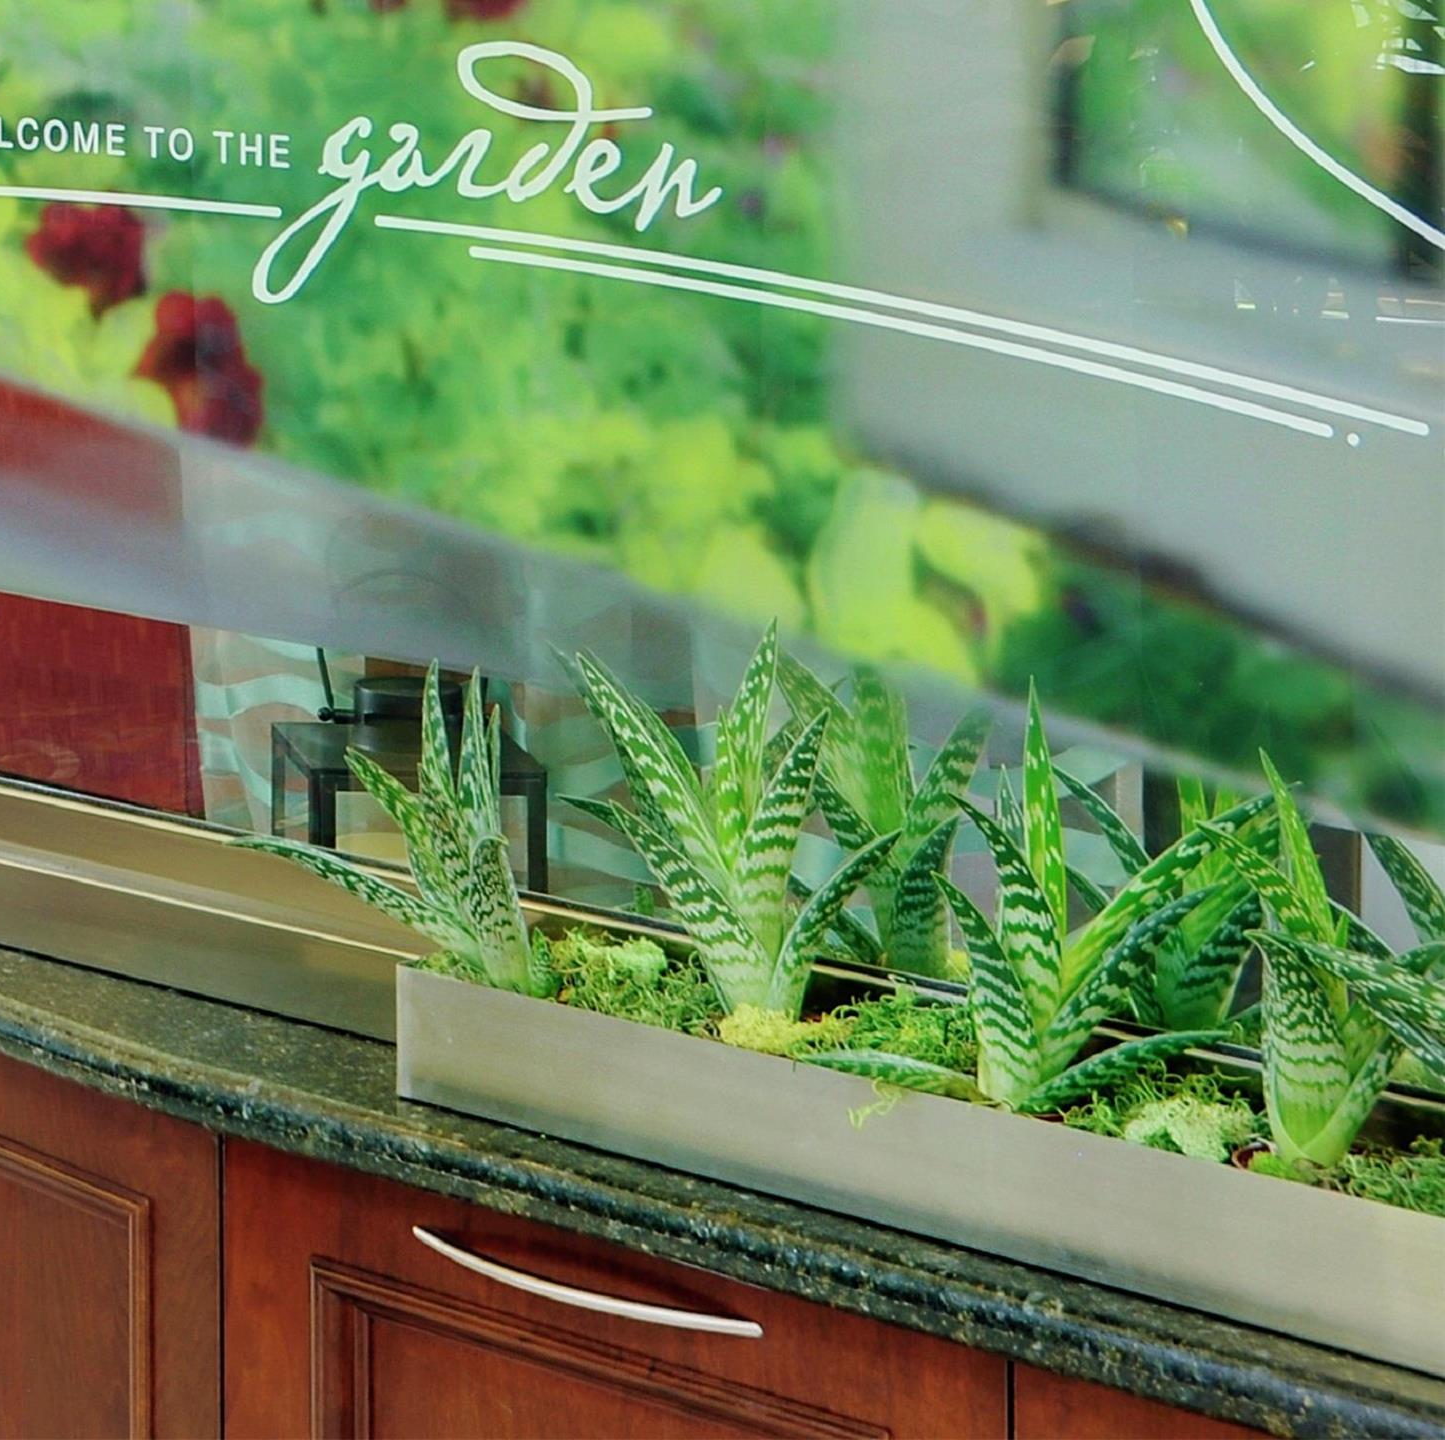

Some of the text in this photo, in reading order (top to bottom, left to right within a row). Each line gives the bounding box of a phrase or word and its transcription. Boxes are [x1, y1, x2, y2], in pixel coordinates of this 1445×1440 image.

[143, 126, 193, 161] TO
[212, 130, 290, 168] THE
[252, 41, 722, 305] garden
